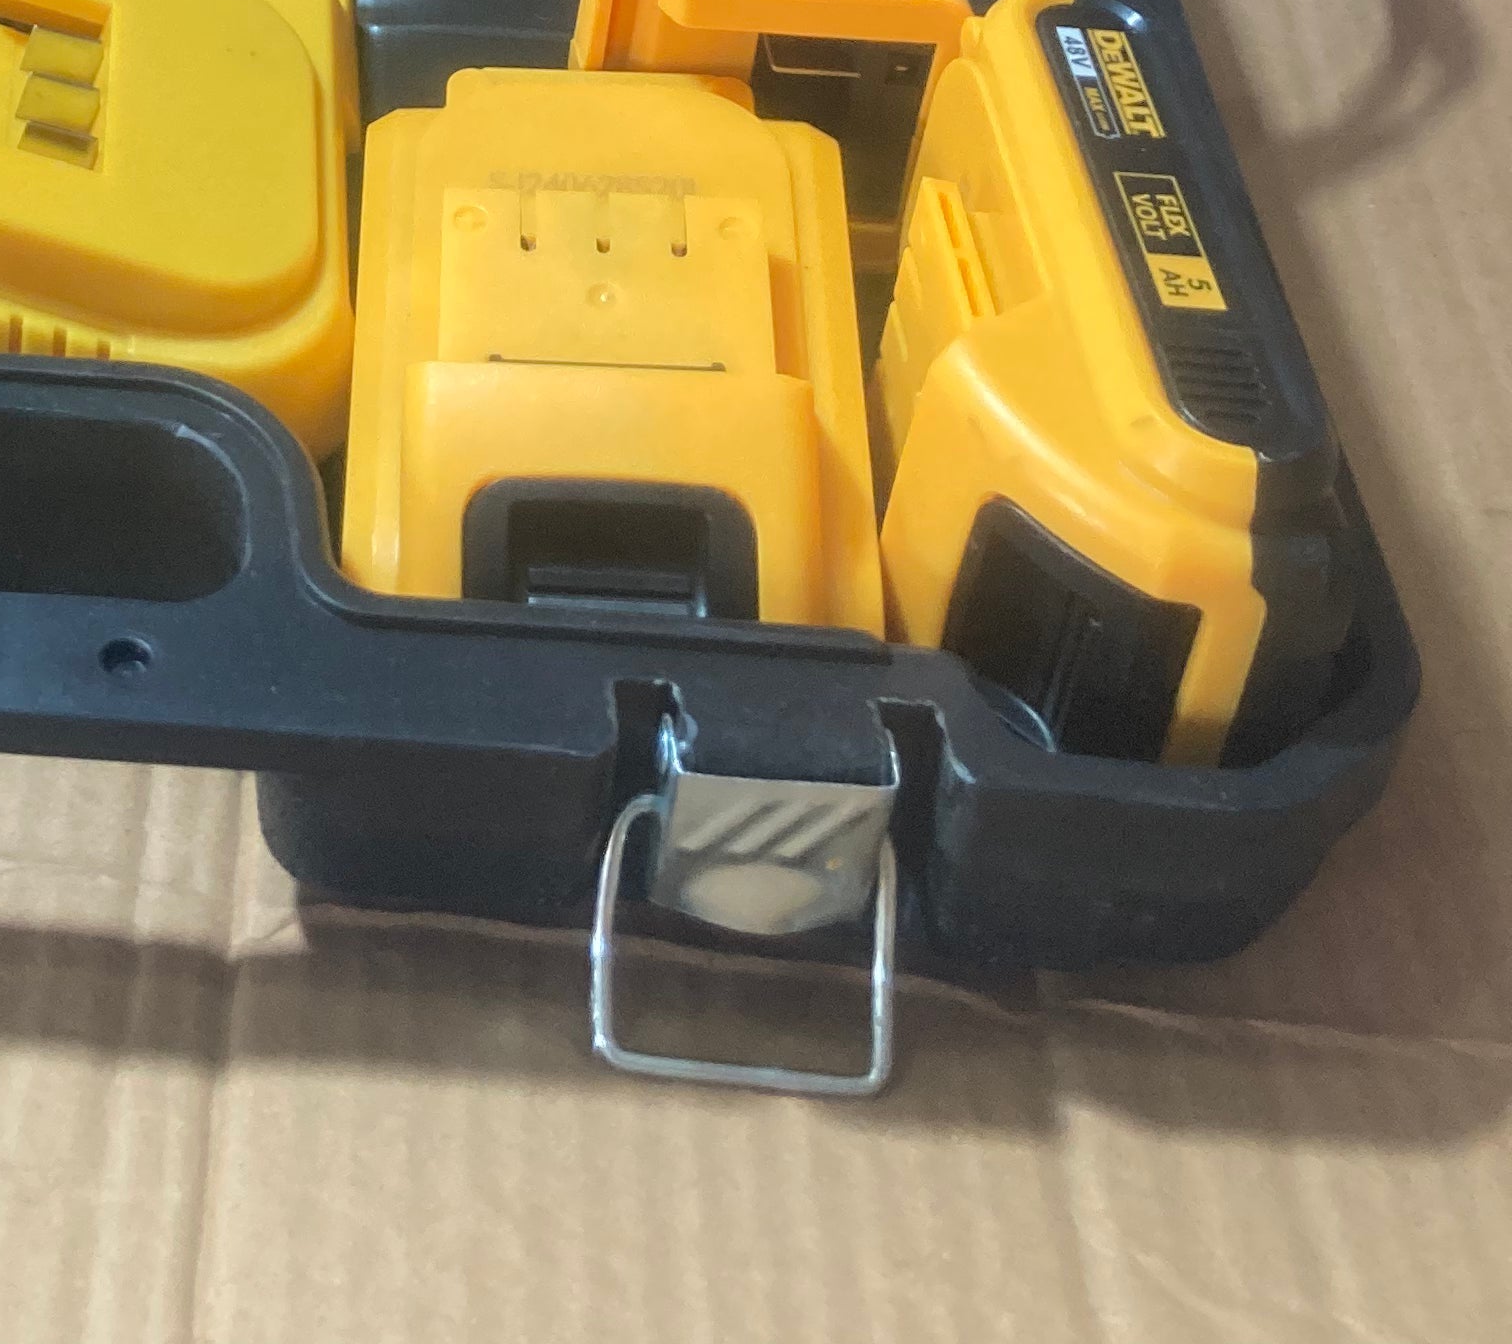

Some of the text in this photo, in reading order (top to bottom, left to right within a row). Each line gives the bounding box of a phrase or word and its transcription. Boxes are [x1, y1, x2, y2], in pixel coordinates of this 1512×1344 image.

[1064, 35, 1092, 69] 48V
[1084, 87, 1106, 112] MAX
[1132, 193, 1167, 241] VOLT
[1155, 194, 1191, 237] FLEX
[1159, 267, 1189, 298] AH
[1188, 278, 1212, 291] 5
